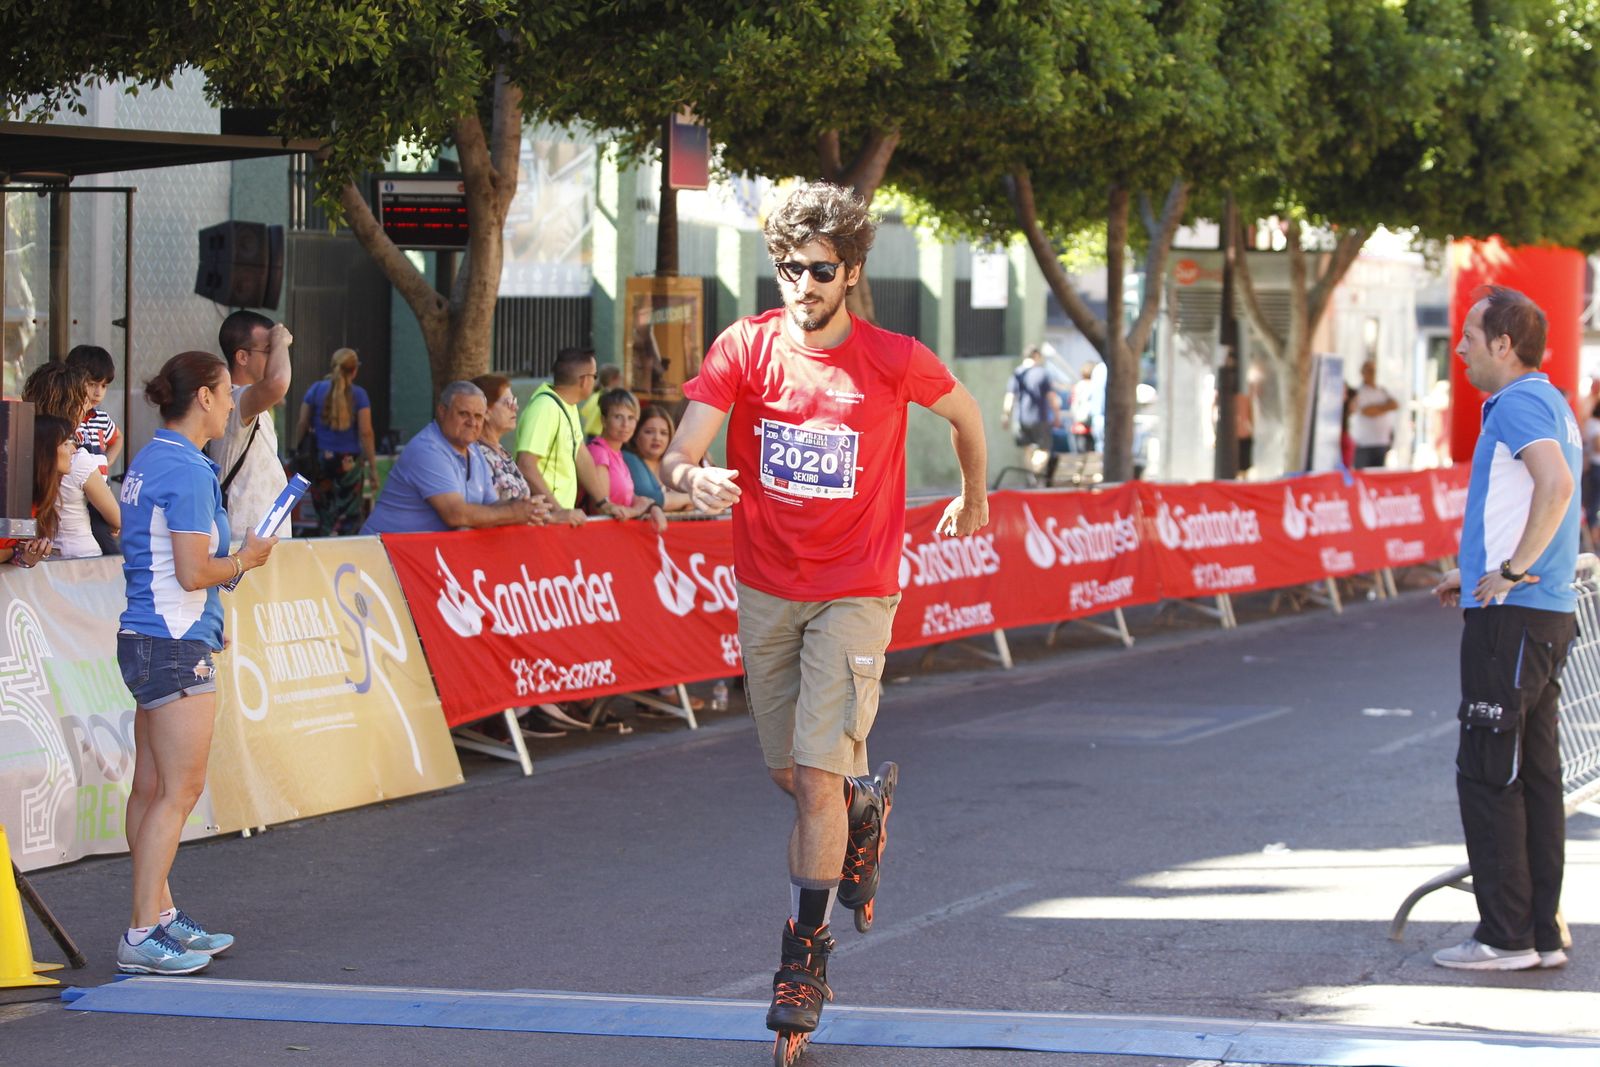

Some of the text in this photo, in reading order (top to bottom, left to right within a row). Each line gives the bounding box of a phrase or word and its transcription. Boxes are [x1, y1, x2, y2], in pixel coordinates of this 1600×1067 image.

[768, 442, 838, 475] 2020
[792, 471, 819, 484] SEKIRO
[1046, 511, 1140, 566] Santander
[1174, 502, 1262, 551] Santander
[253, 597, 341, 645] CARRERA
[473, 559, 621, 637] Santander
